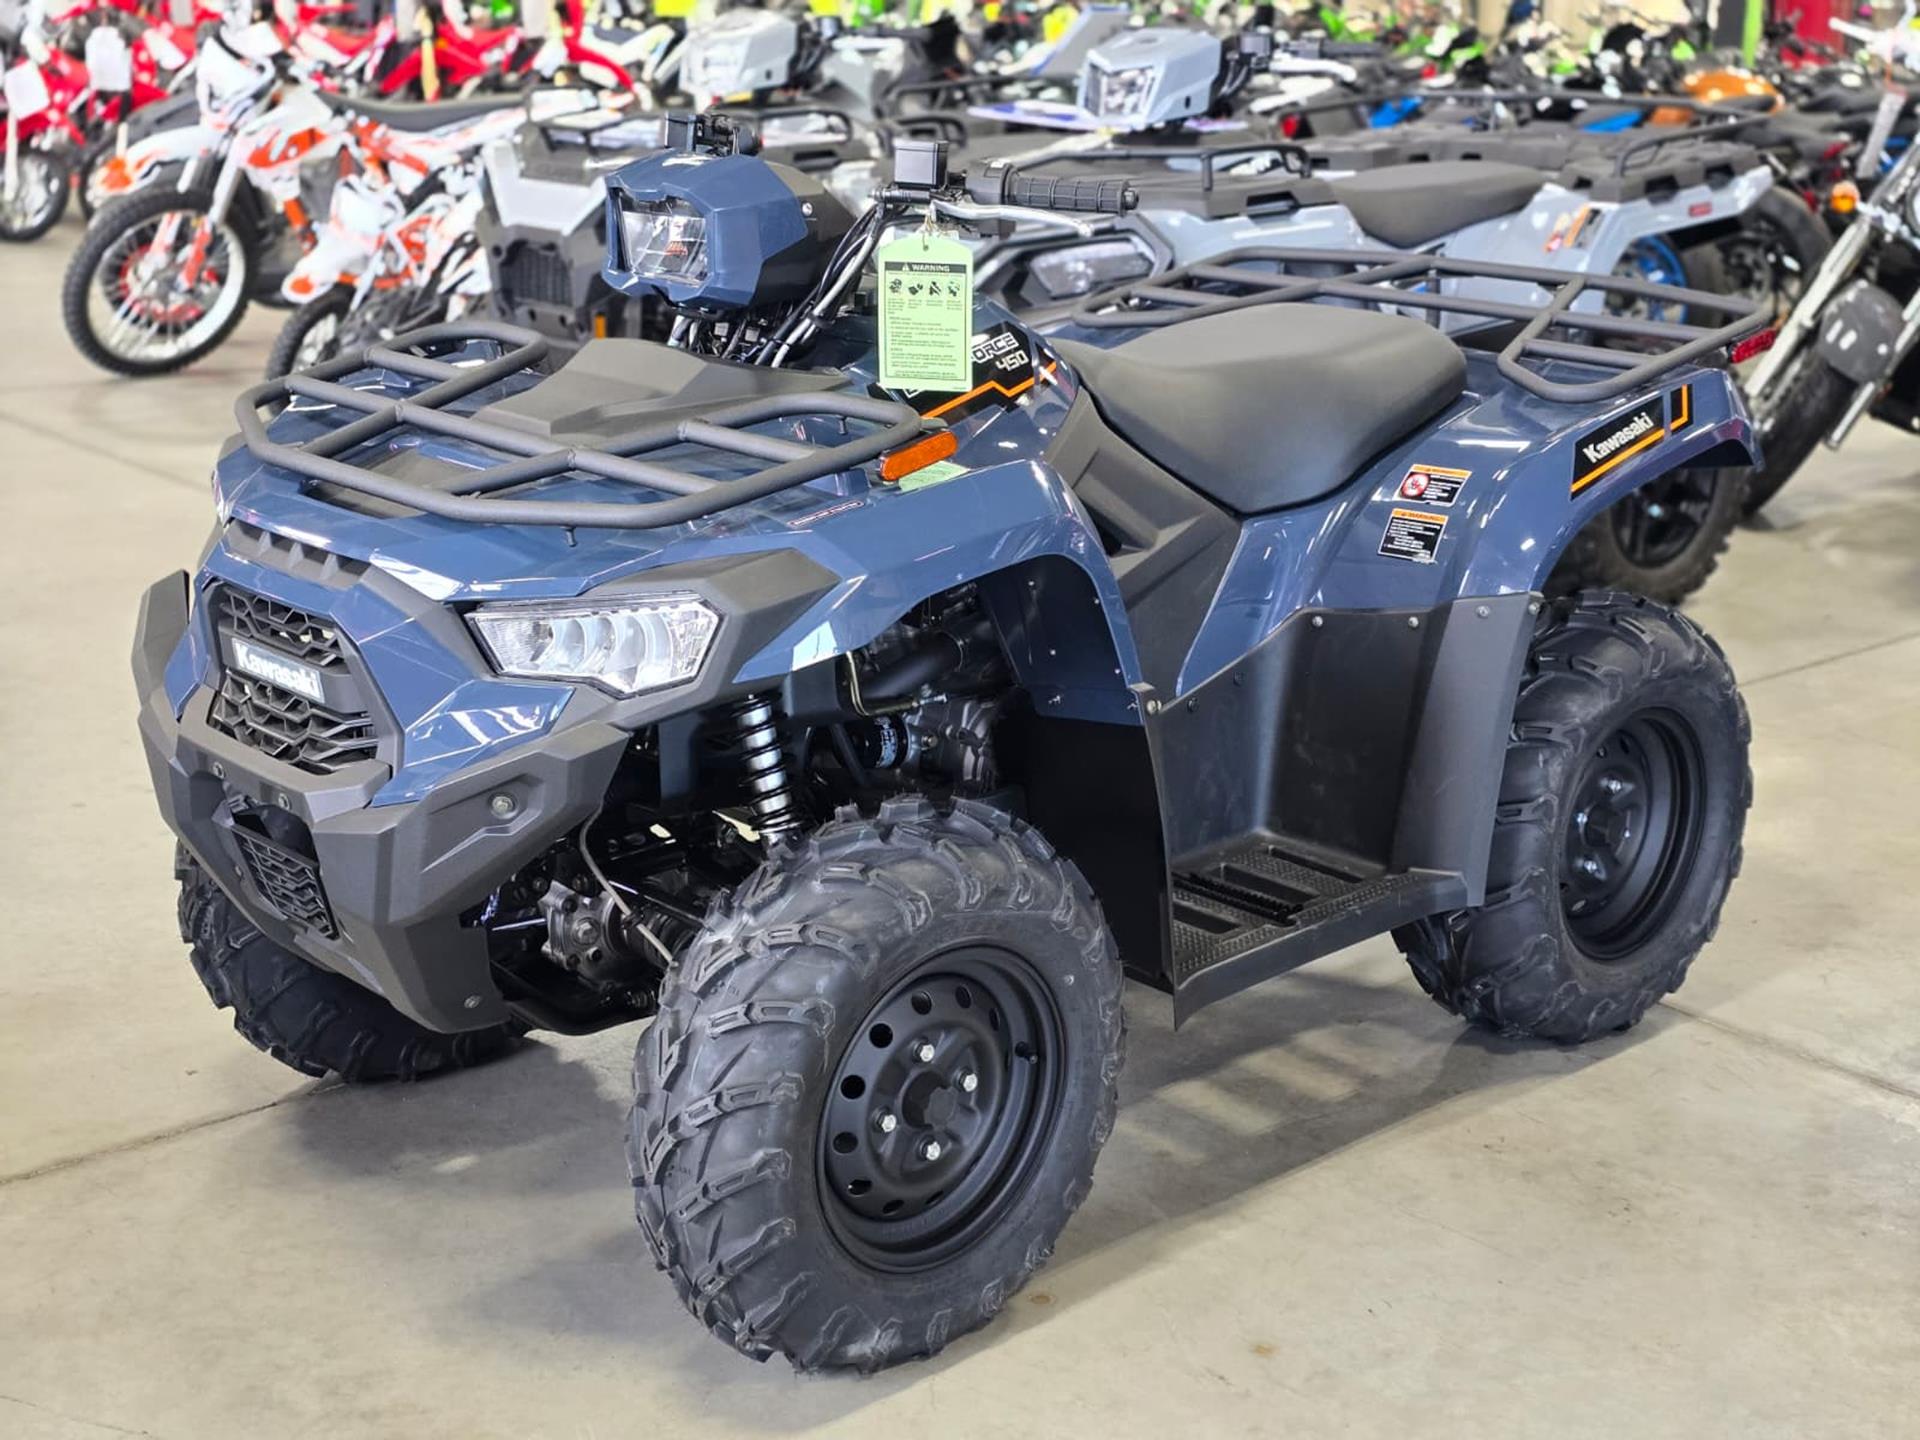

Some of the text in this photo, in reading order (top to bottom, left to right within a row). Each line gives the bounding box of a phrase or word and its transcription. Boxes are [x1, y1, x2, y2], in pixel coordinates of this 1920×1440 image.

[911, 263, 951, 272] WARNING
[971, 332, 1020, 364] ORCE
[995, 349, 1030, 372] 450
[1582, 411, 1655, 464] Kawasaki
[234, 642, 321, 700] Kawasaki
